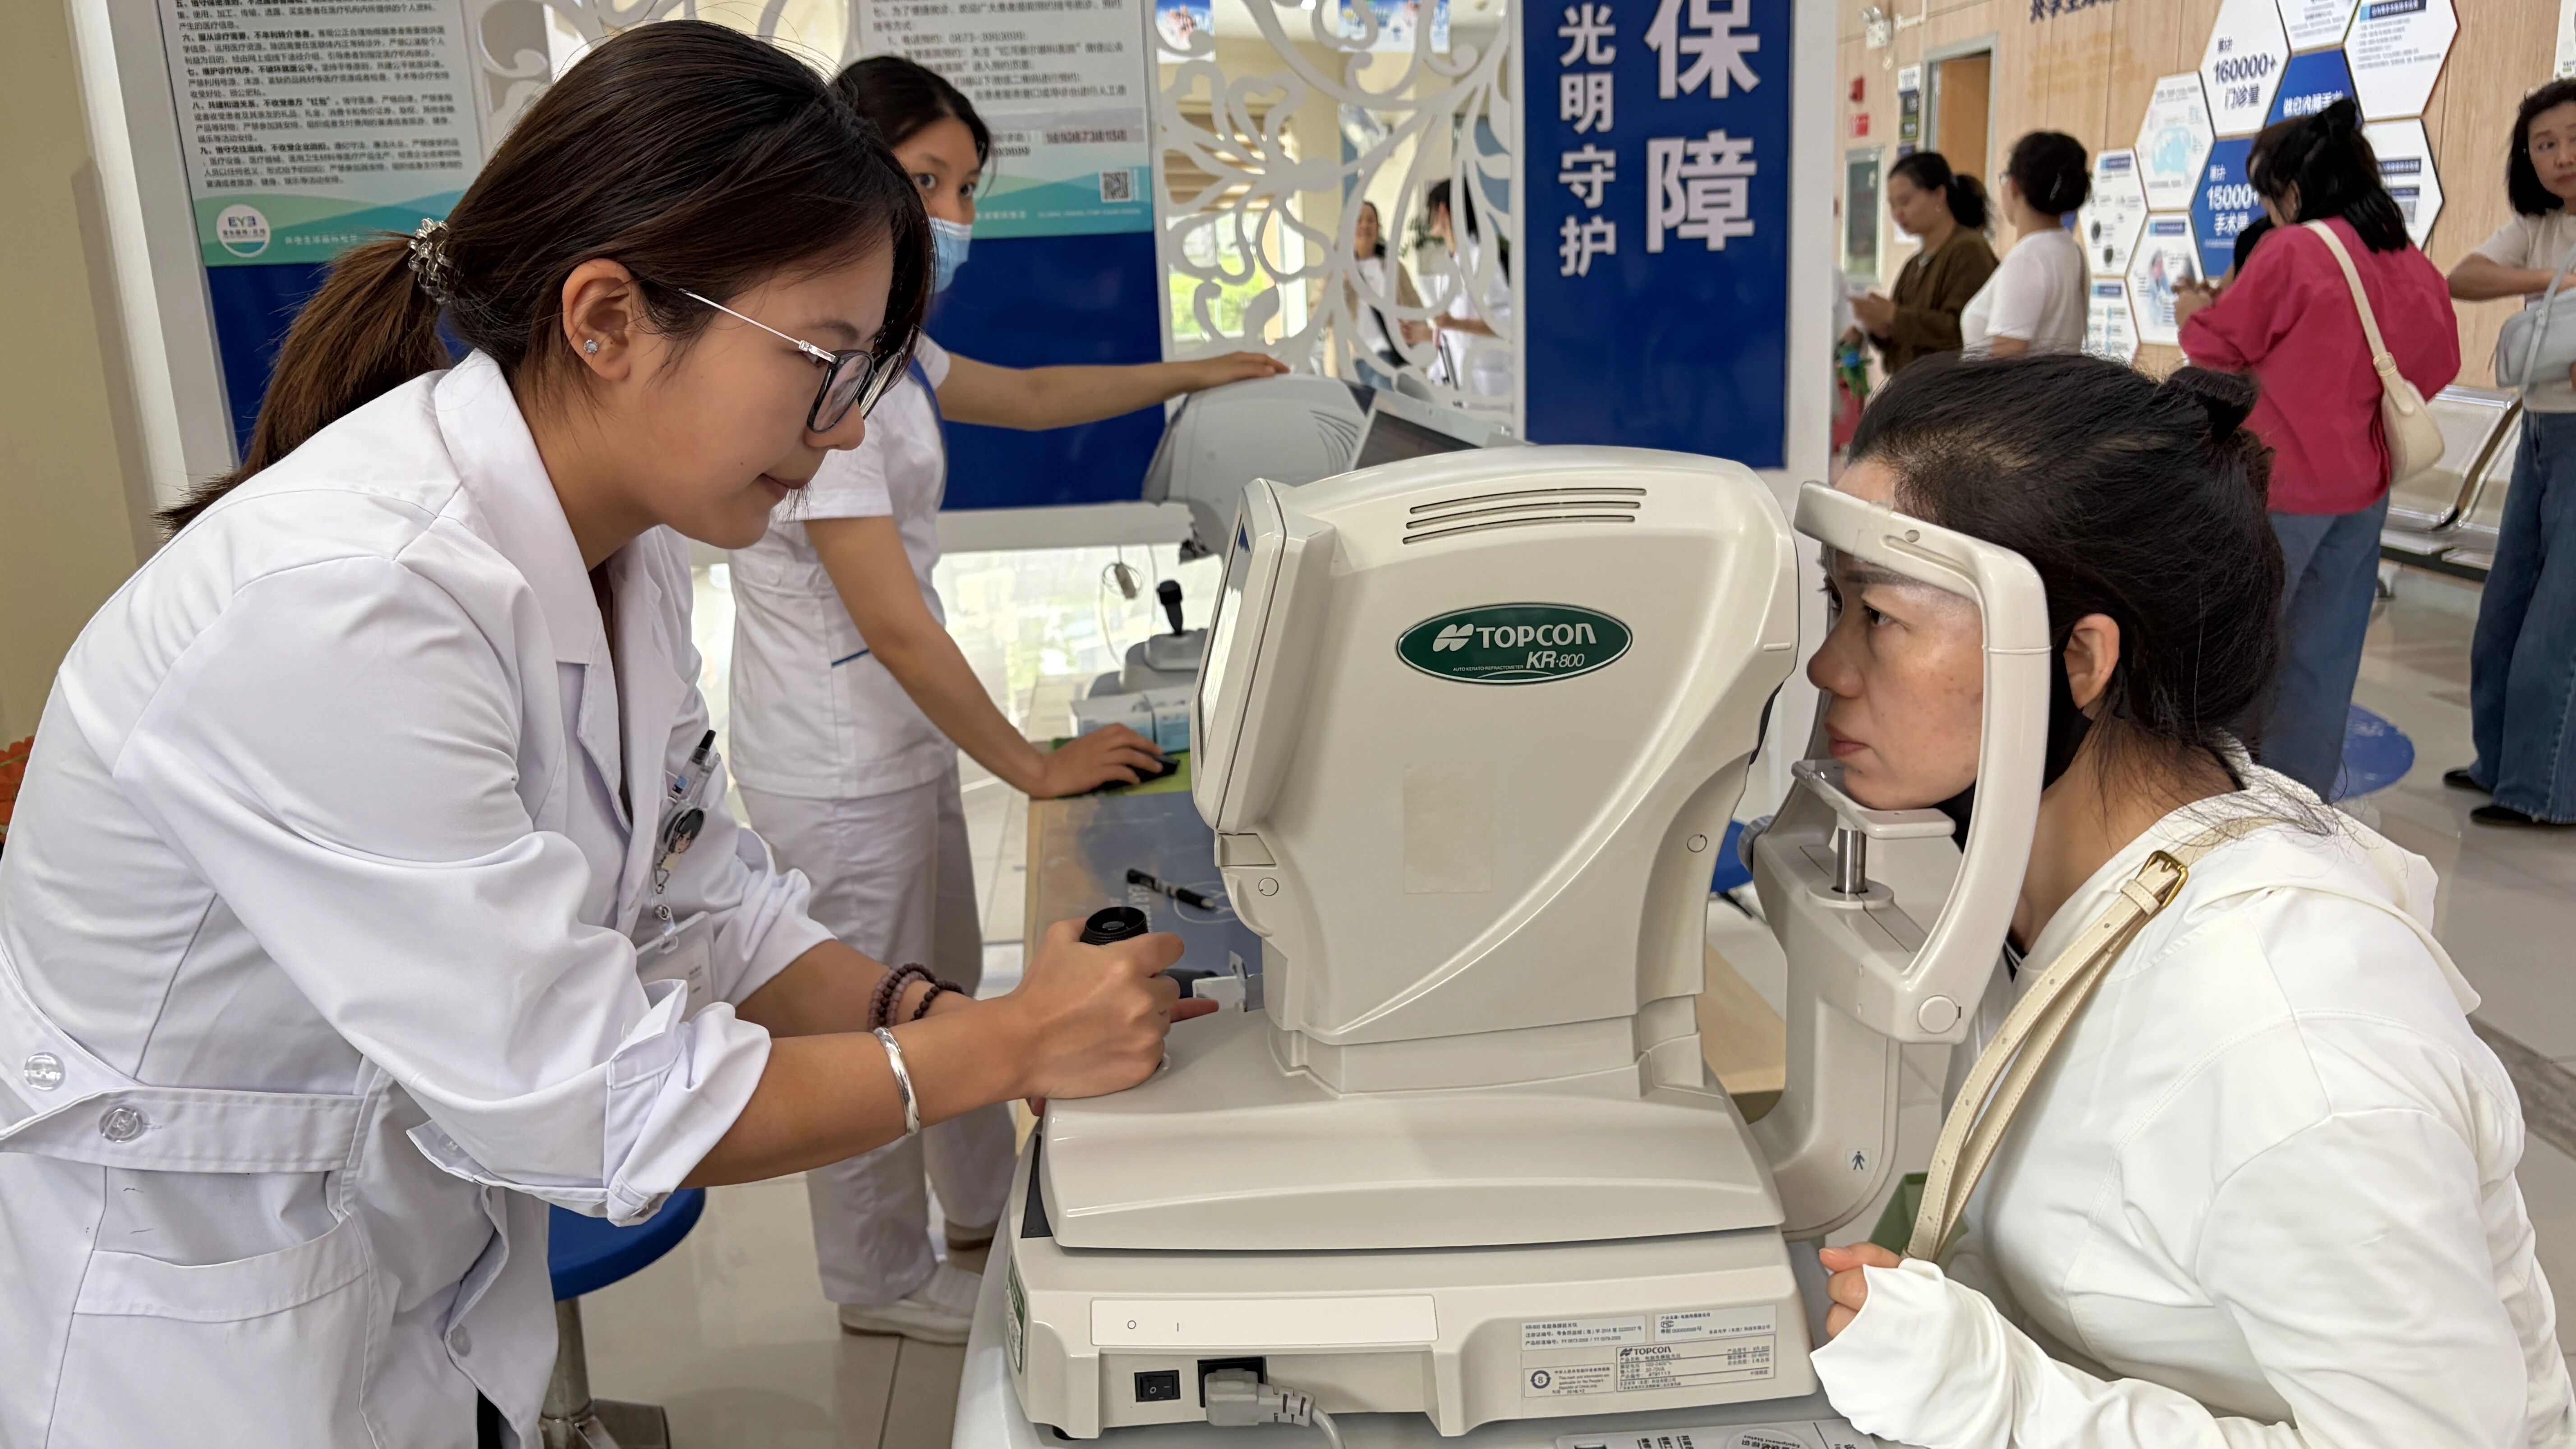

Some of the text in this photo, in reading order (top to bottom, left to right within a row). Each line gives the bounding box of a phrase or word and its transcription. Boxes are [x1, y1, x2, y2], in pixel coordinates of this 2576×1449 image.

[2213, 52, 2277, 84] 160000+
[2224, 83, 2260, 110] 门诊量
[1558, 2, 1617, 277] 光明守护
[1644, 0, 1762, 253] 保障
[1476, 623, 1597, 648] TOPCON
[1633, 1346, 1672, 1355] TOPCON
